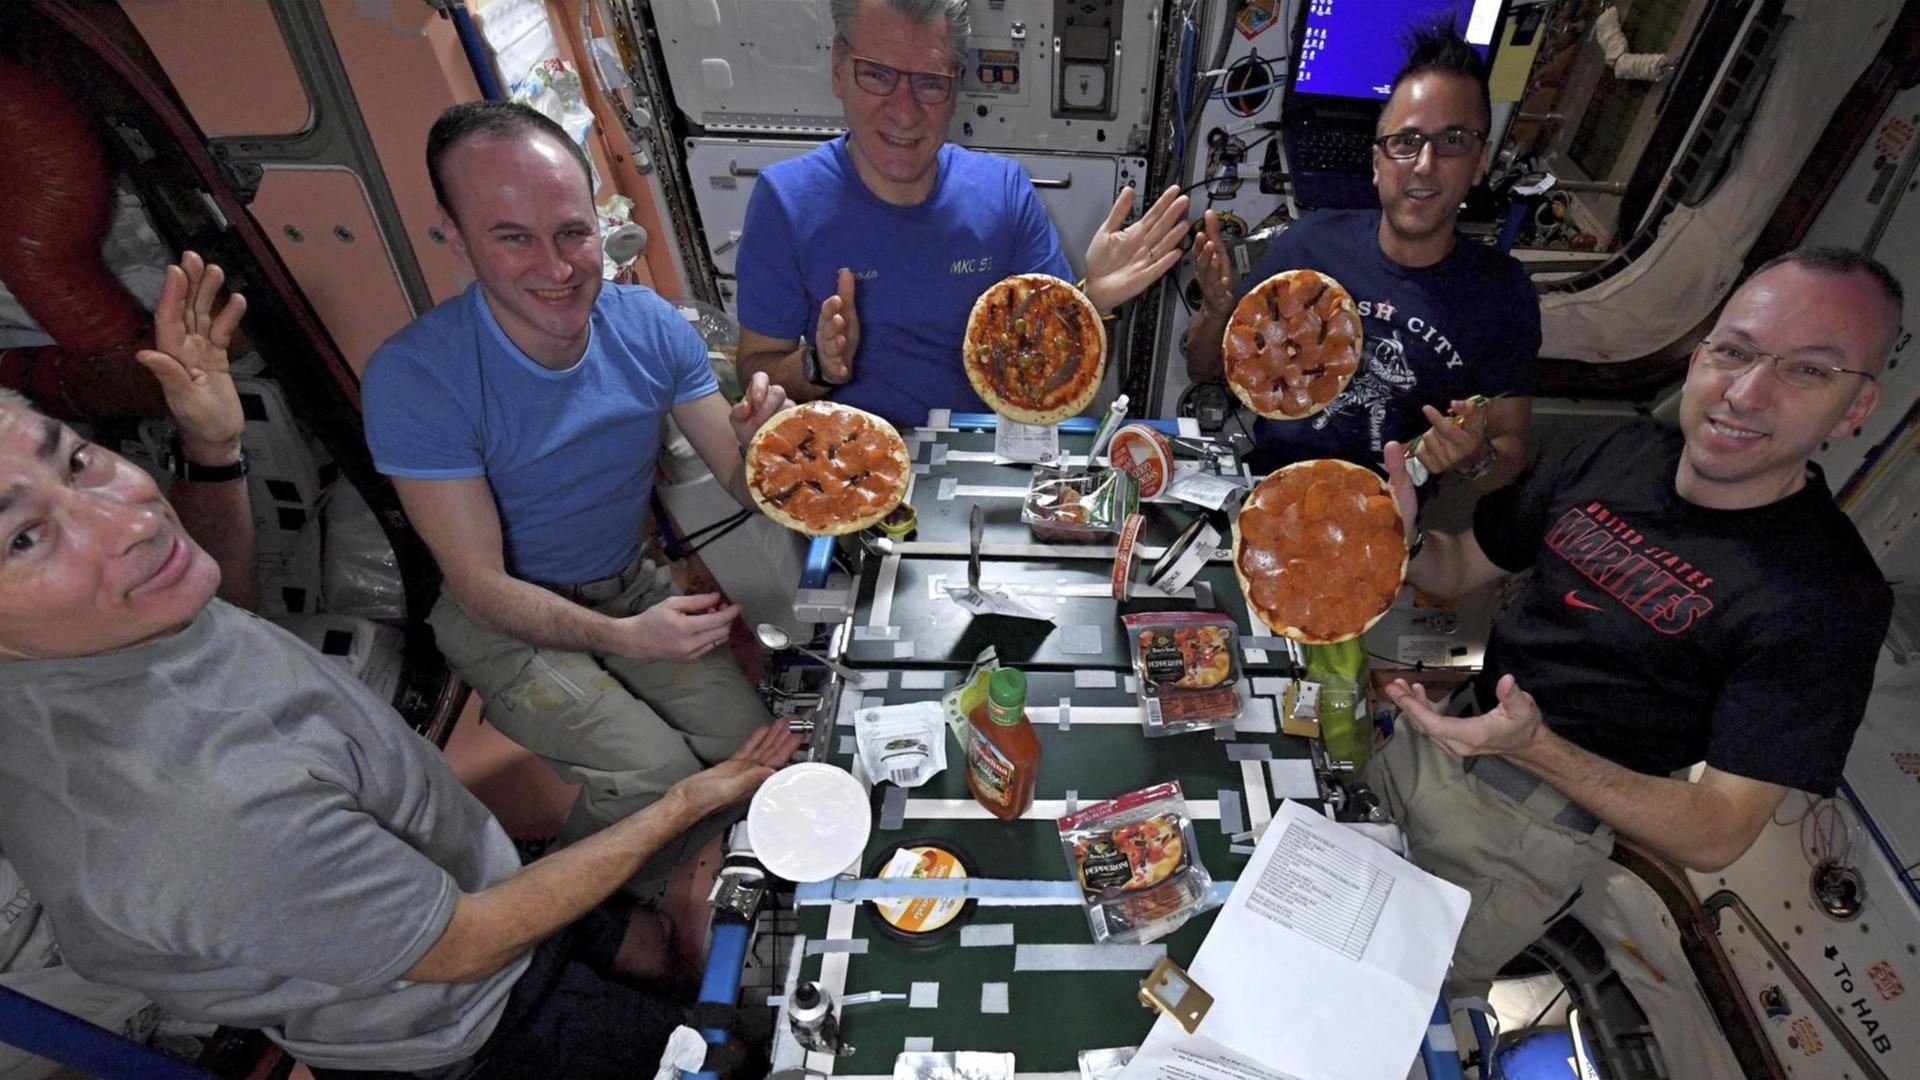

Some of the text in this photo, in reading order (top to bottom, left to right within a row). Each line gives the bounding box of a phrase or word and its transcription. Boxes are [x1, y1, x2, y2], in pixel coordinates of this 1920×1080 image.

[1407, 316, 1464, 369] CITY
[1544, 507, 1714, 634] MARINES
[1586, 502, 1714, 589] UNITED STATES
[1085, 862, 1129, 876] PEPPERONI
[1851, 998, 1892, 1054] HAB
